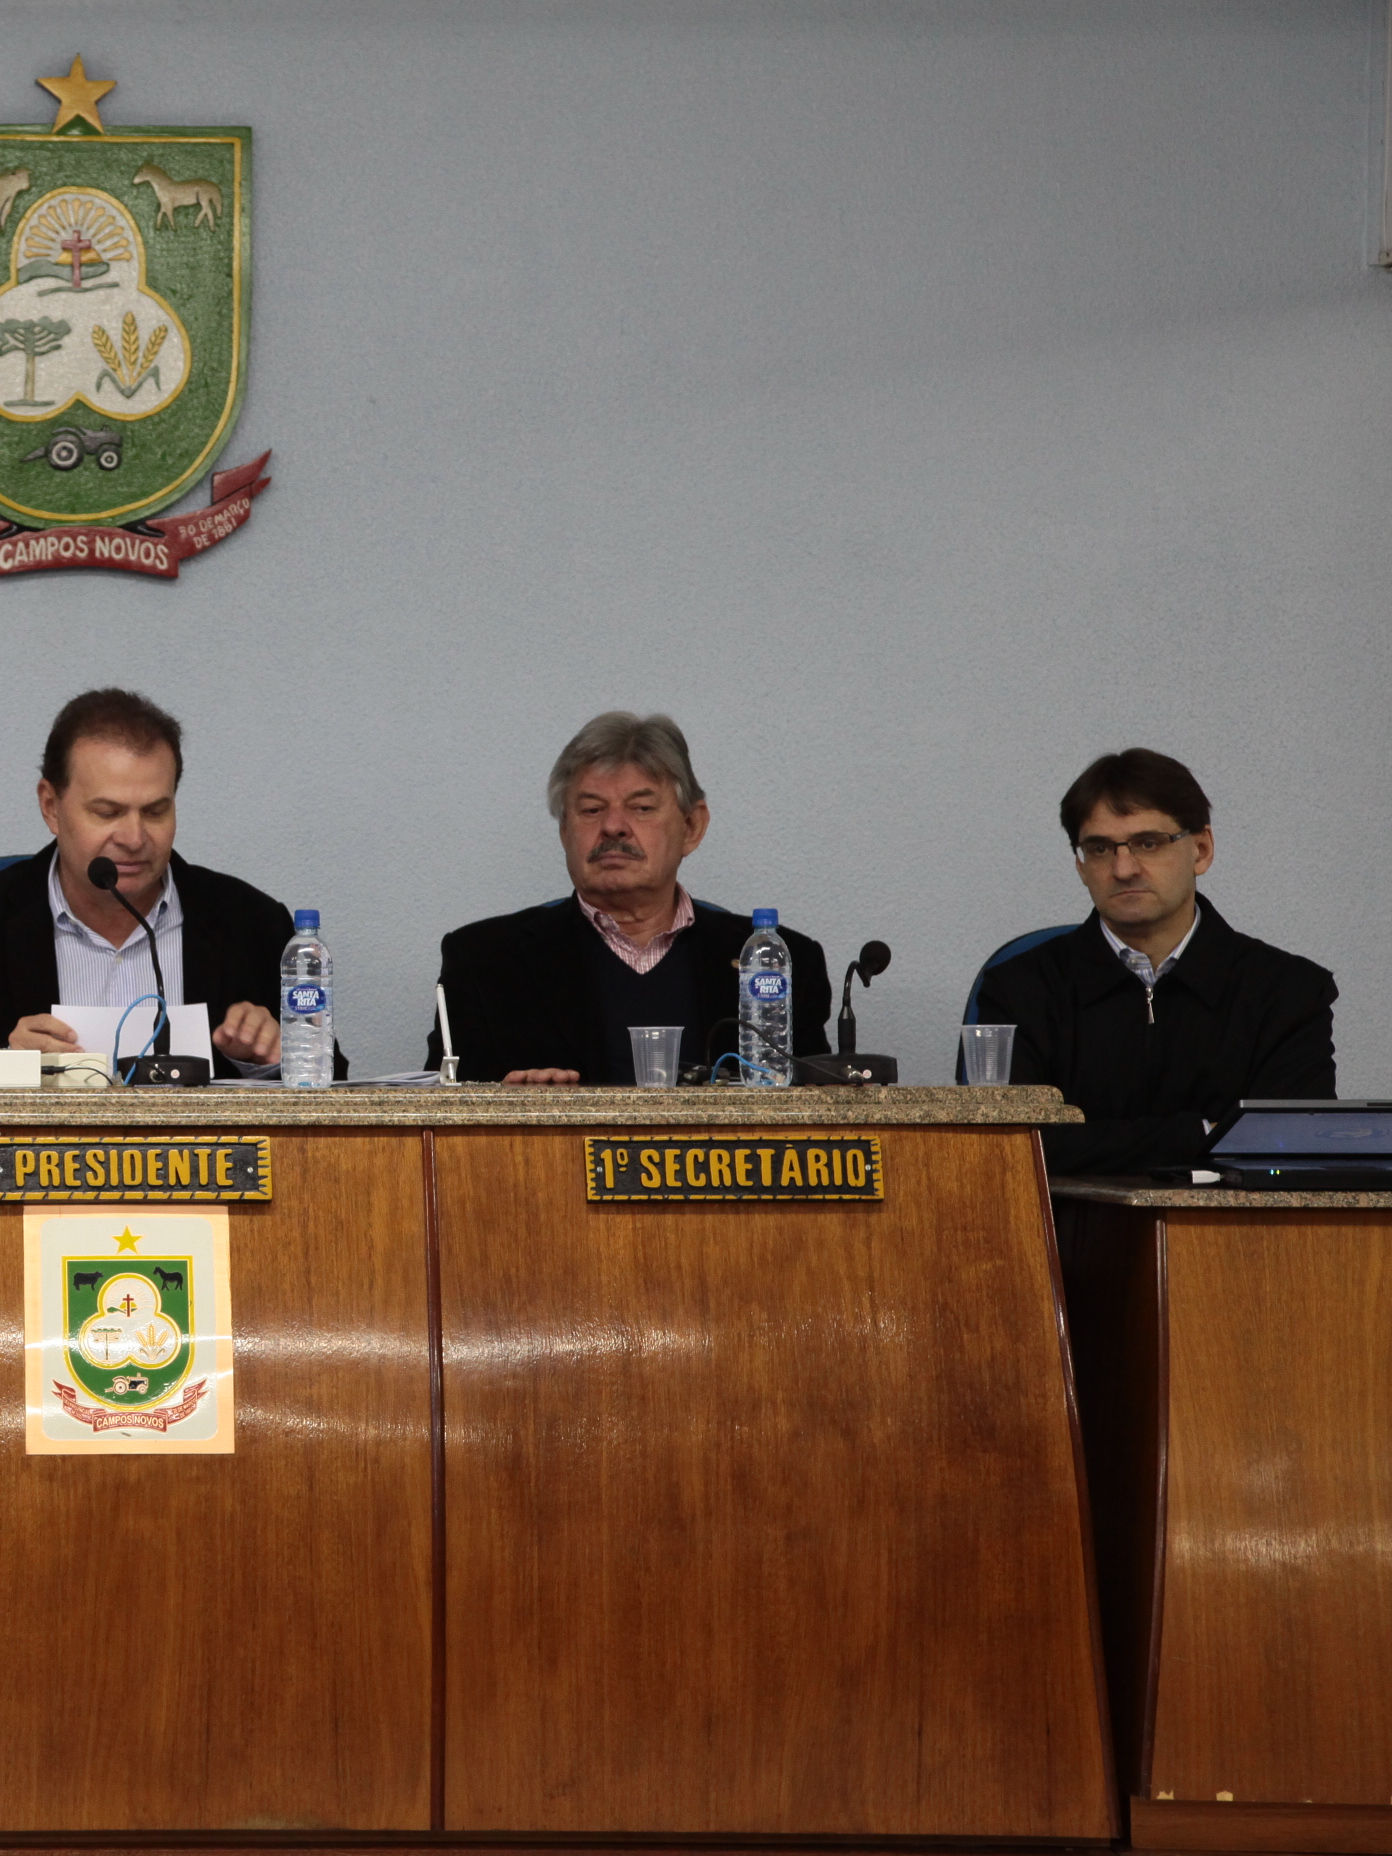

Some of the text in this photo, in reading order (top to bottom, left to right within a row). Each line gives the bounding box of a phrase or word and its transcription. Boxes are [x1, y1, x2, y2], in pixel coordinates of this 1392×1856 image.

[198, 517, 214, 533] DE
[193, 534, 210, 549] DE
[95, 536, 169, 570] NOVOS
[754, 977, 782, 987] SANTA
[292, 990, 319, 1000] SANTA
[759, 985, 779, 994] RITA
[297, 998, 316, 1007] RITA
[14, 1148, 235, 1188] PRESIDENTE
[600, 1143, 867, 1190] 1º SECRETÁRIO
[96, 1415, 164, 1428] CAMPOS NOVOS
